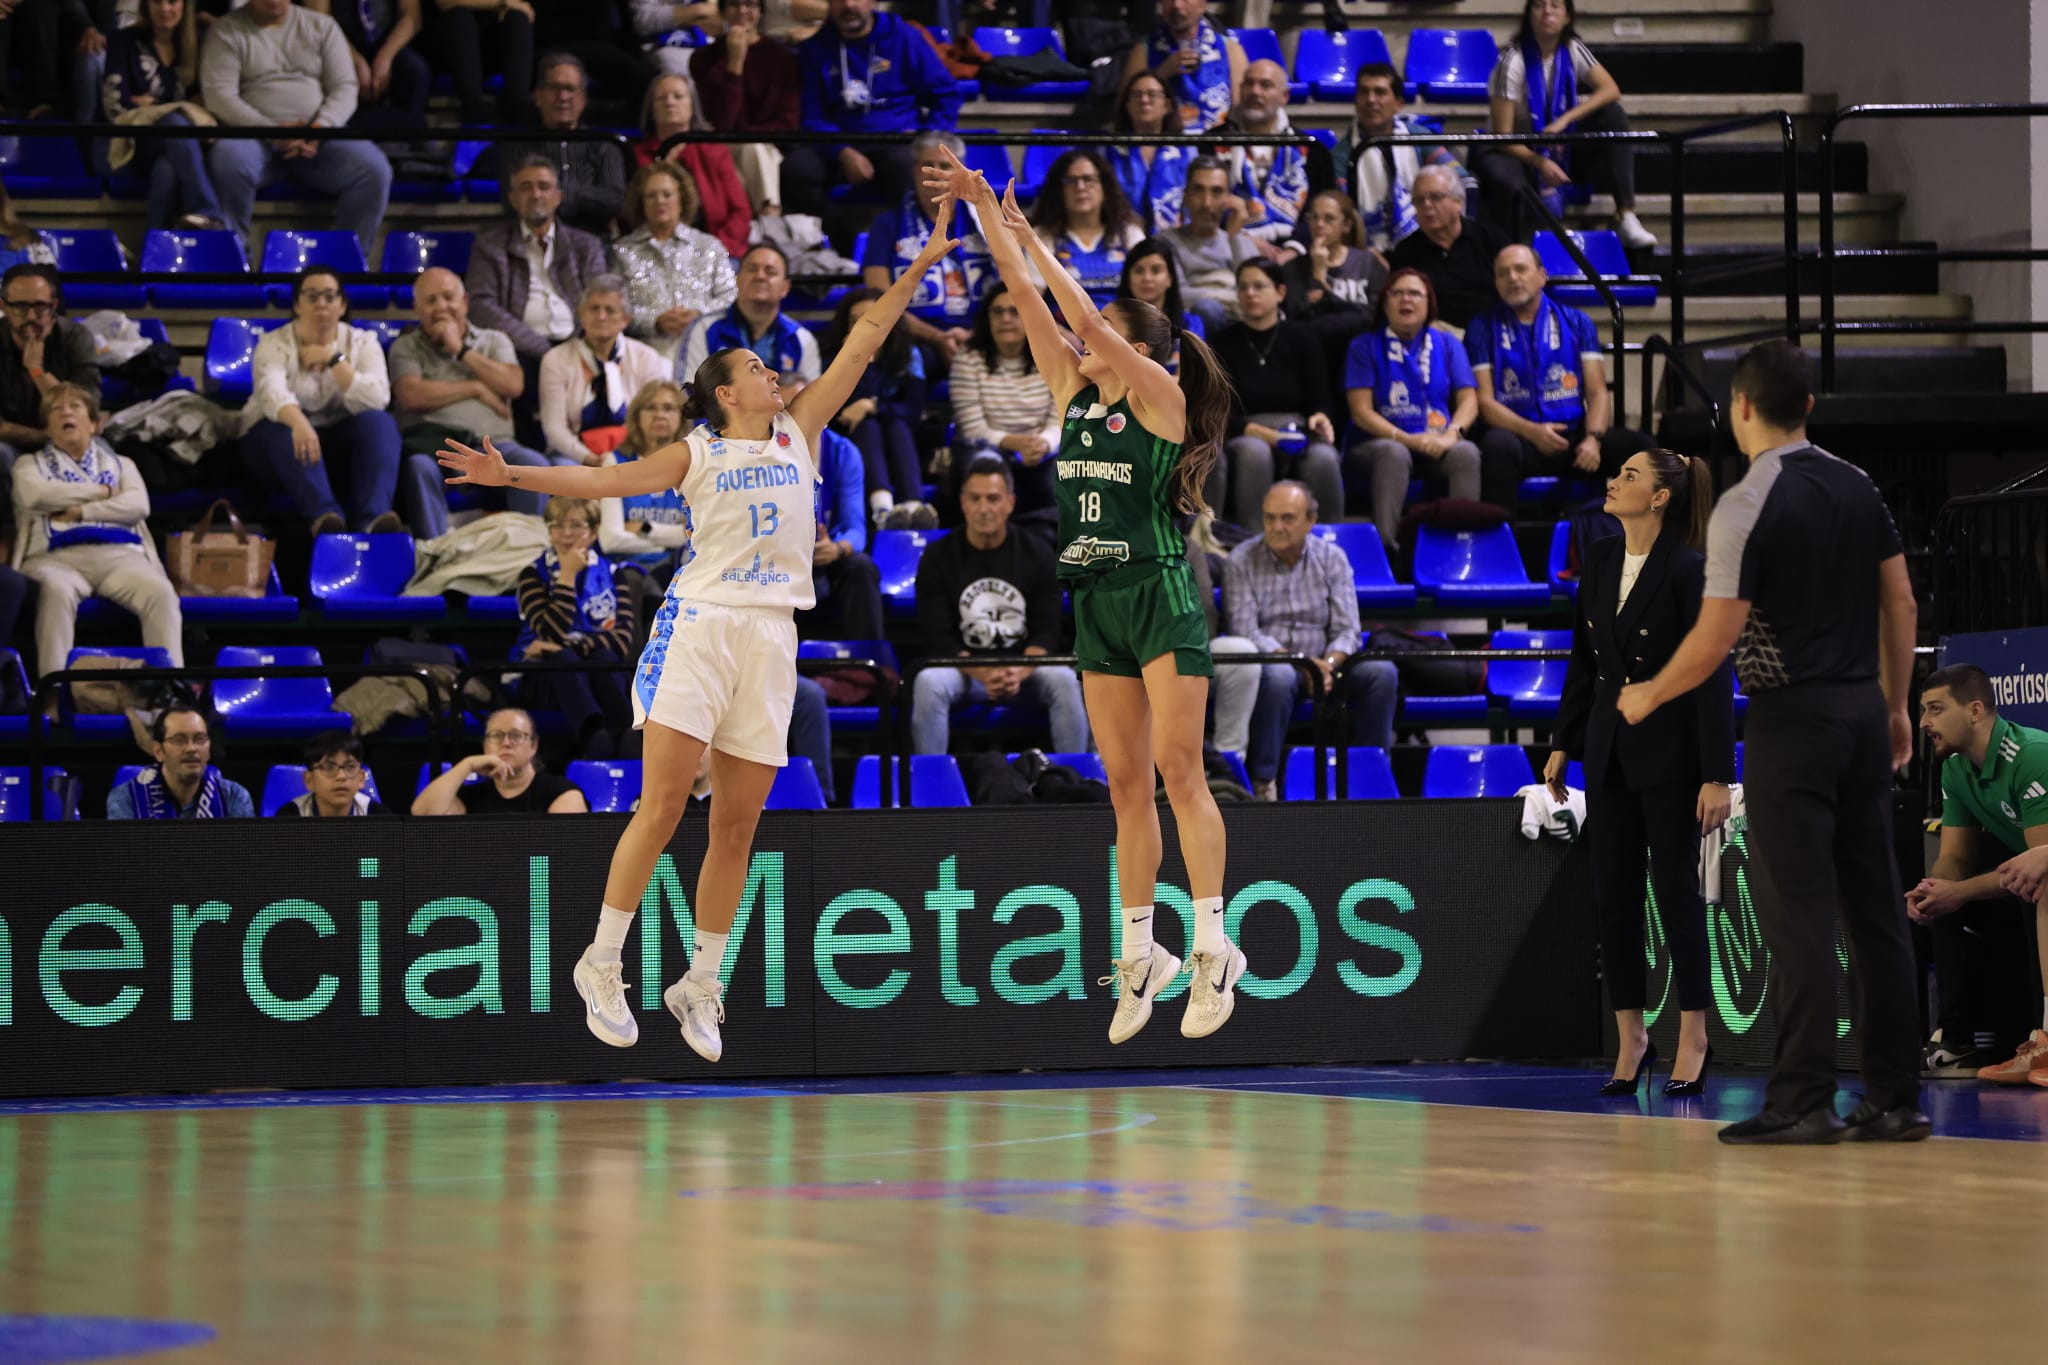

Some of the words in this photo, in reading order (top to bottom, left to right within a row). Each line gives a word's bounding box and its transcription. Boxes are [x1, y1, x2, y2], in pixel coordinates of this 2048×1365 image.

[716, 463, 799, 492] AVENIDA
[748, 502, 778, 538] 13
[1079, 491, 1101, 522] 18
[640, 846, 1423, 1010] Metabos
